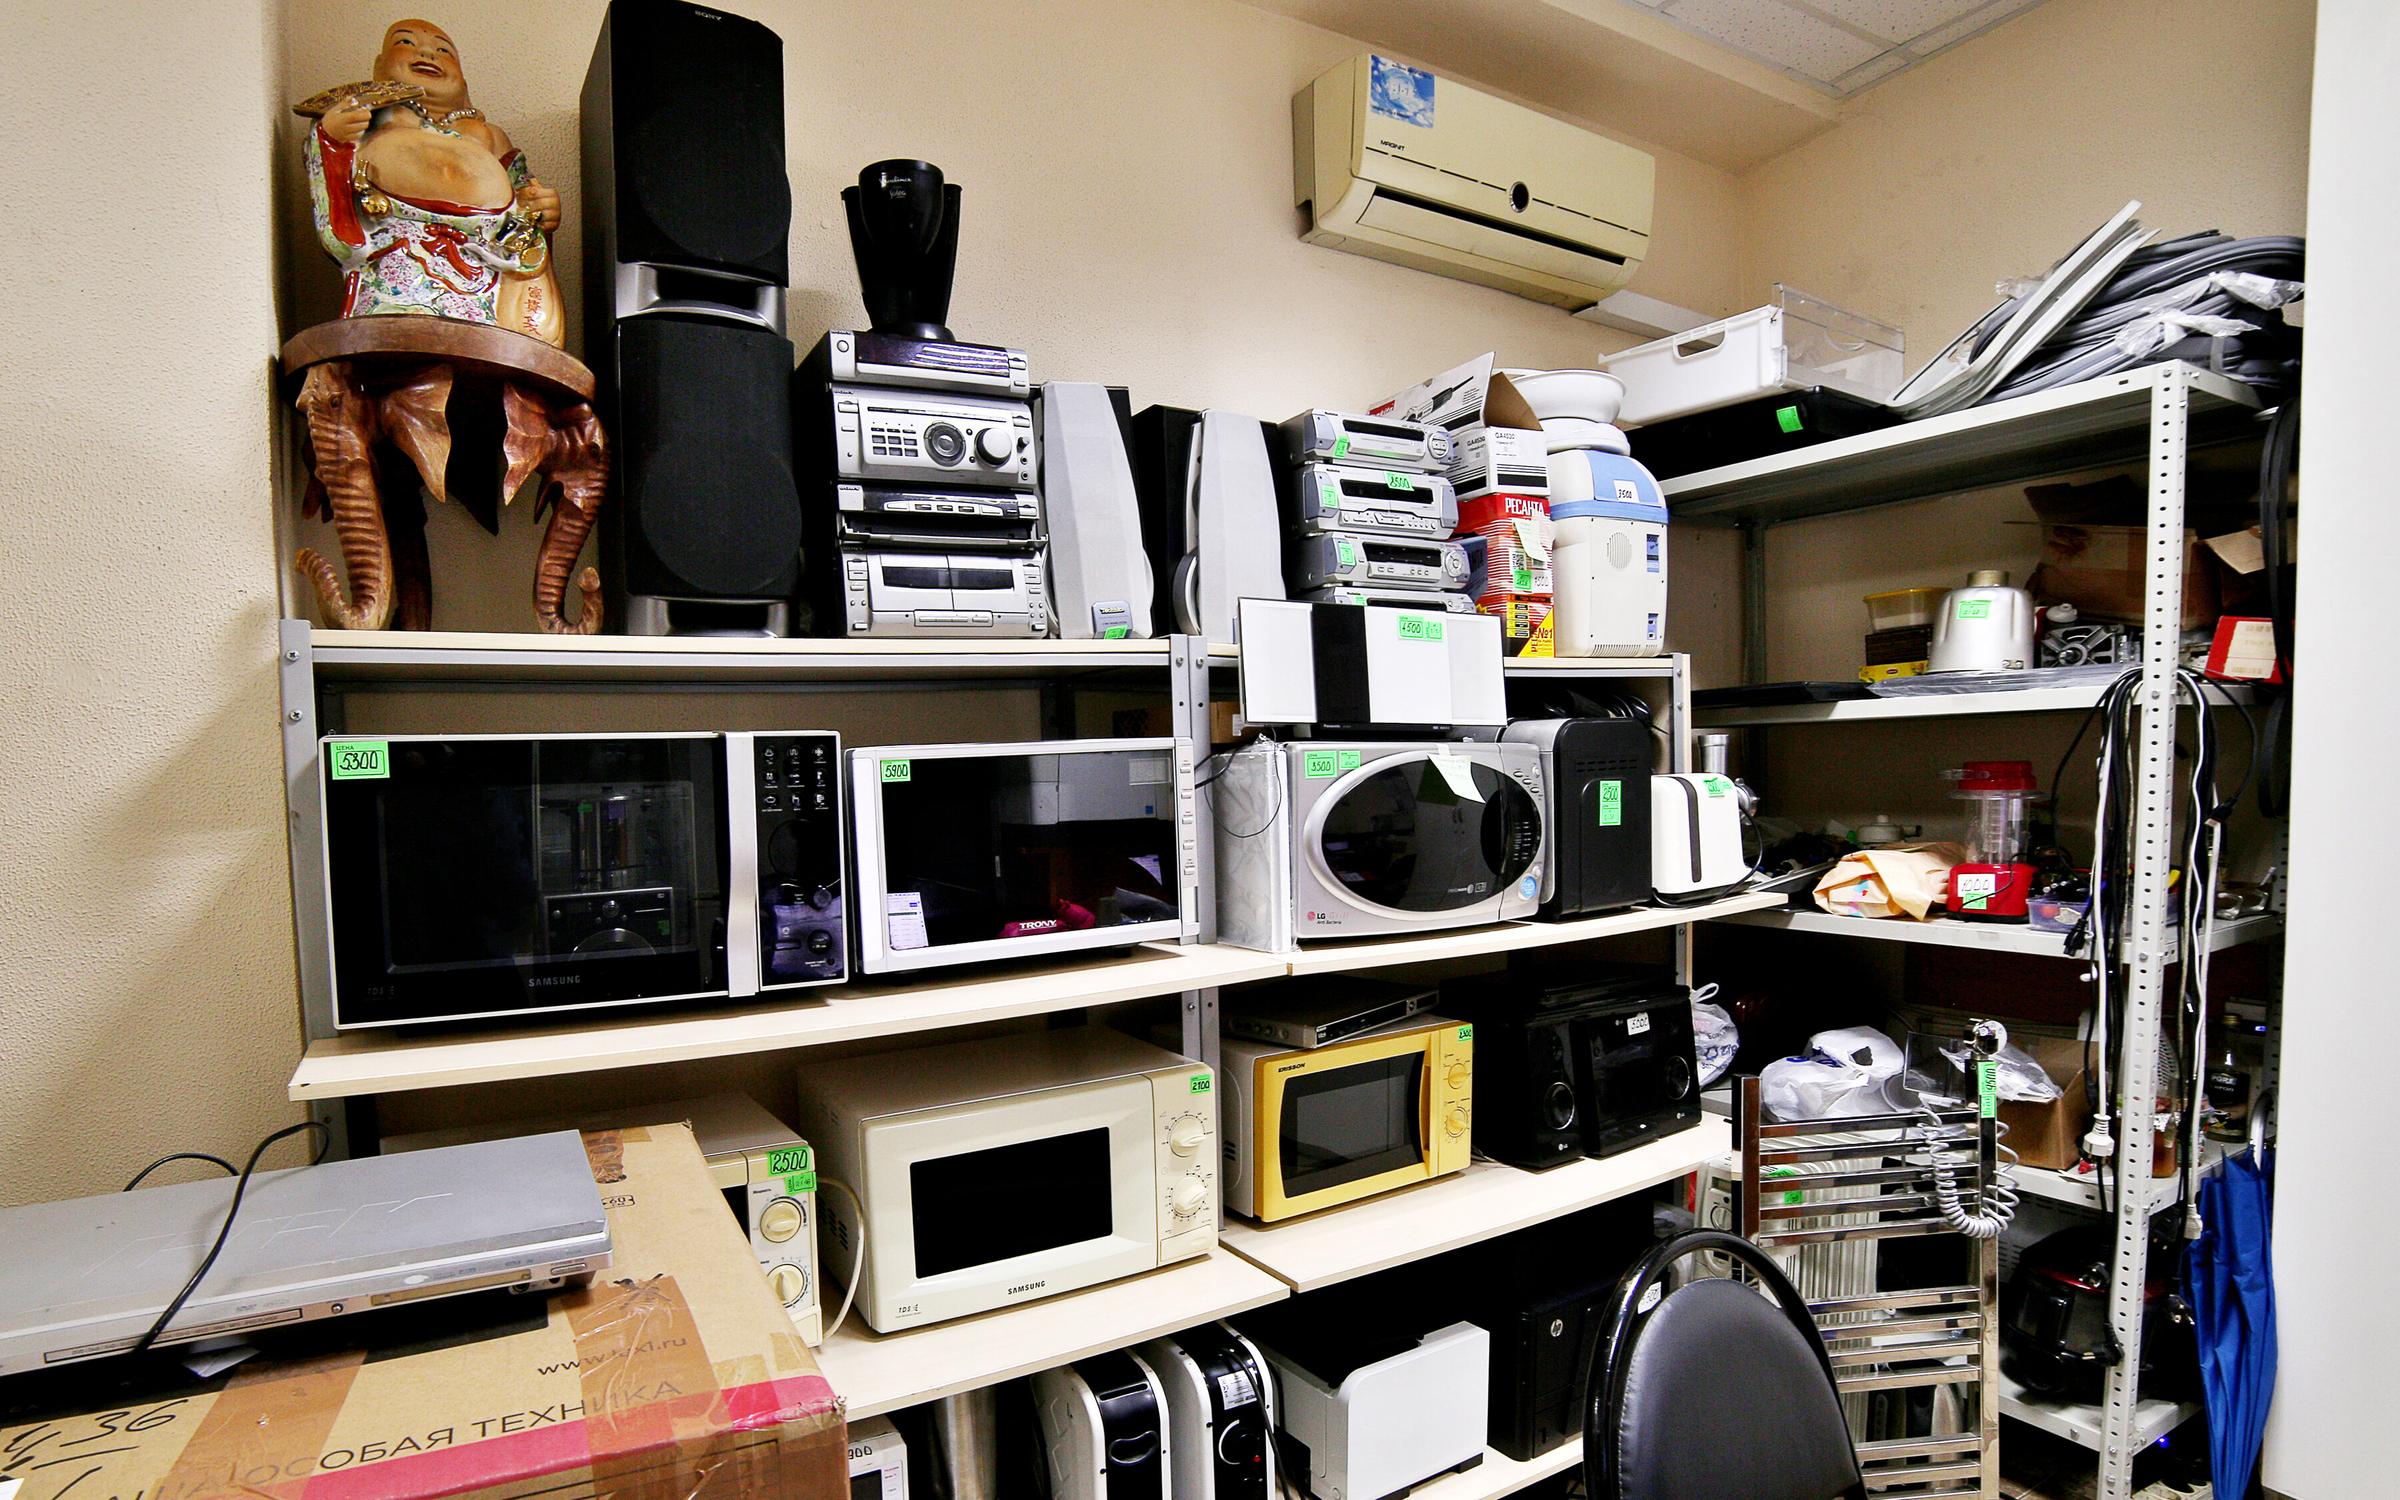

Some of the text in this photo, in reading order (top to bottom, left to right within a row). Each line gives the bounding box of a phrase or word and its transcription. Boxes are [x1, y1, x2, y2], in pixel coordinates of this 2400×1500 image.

[1380, 139, 1405, 152] MAGNIT
[1505, 497, 1545, 517] РЕСАНТА
[339, 750, 379, 771] 5300
[1019, 919, 1058, 930] TRONY
[1316, 912, 1326, 920] LG
[528, 974, 581, 988] SAMSUNG
[772, 1149, 808, 1173] 2500
[1007, 1279, 1046, 1296] SAMSUNG
[245, 1379, 684, 1487] ОСОБАЯ ТЕХНИКА
